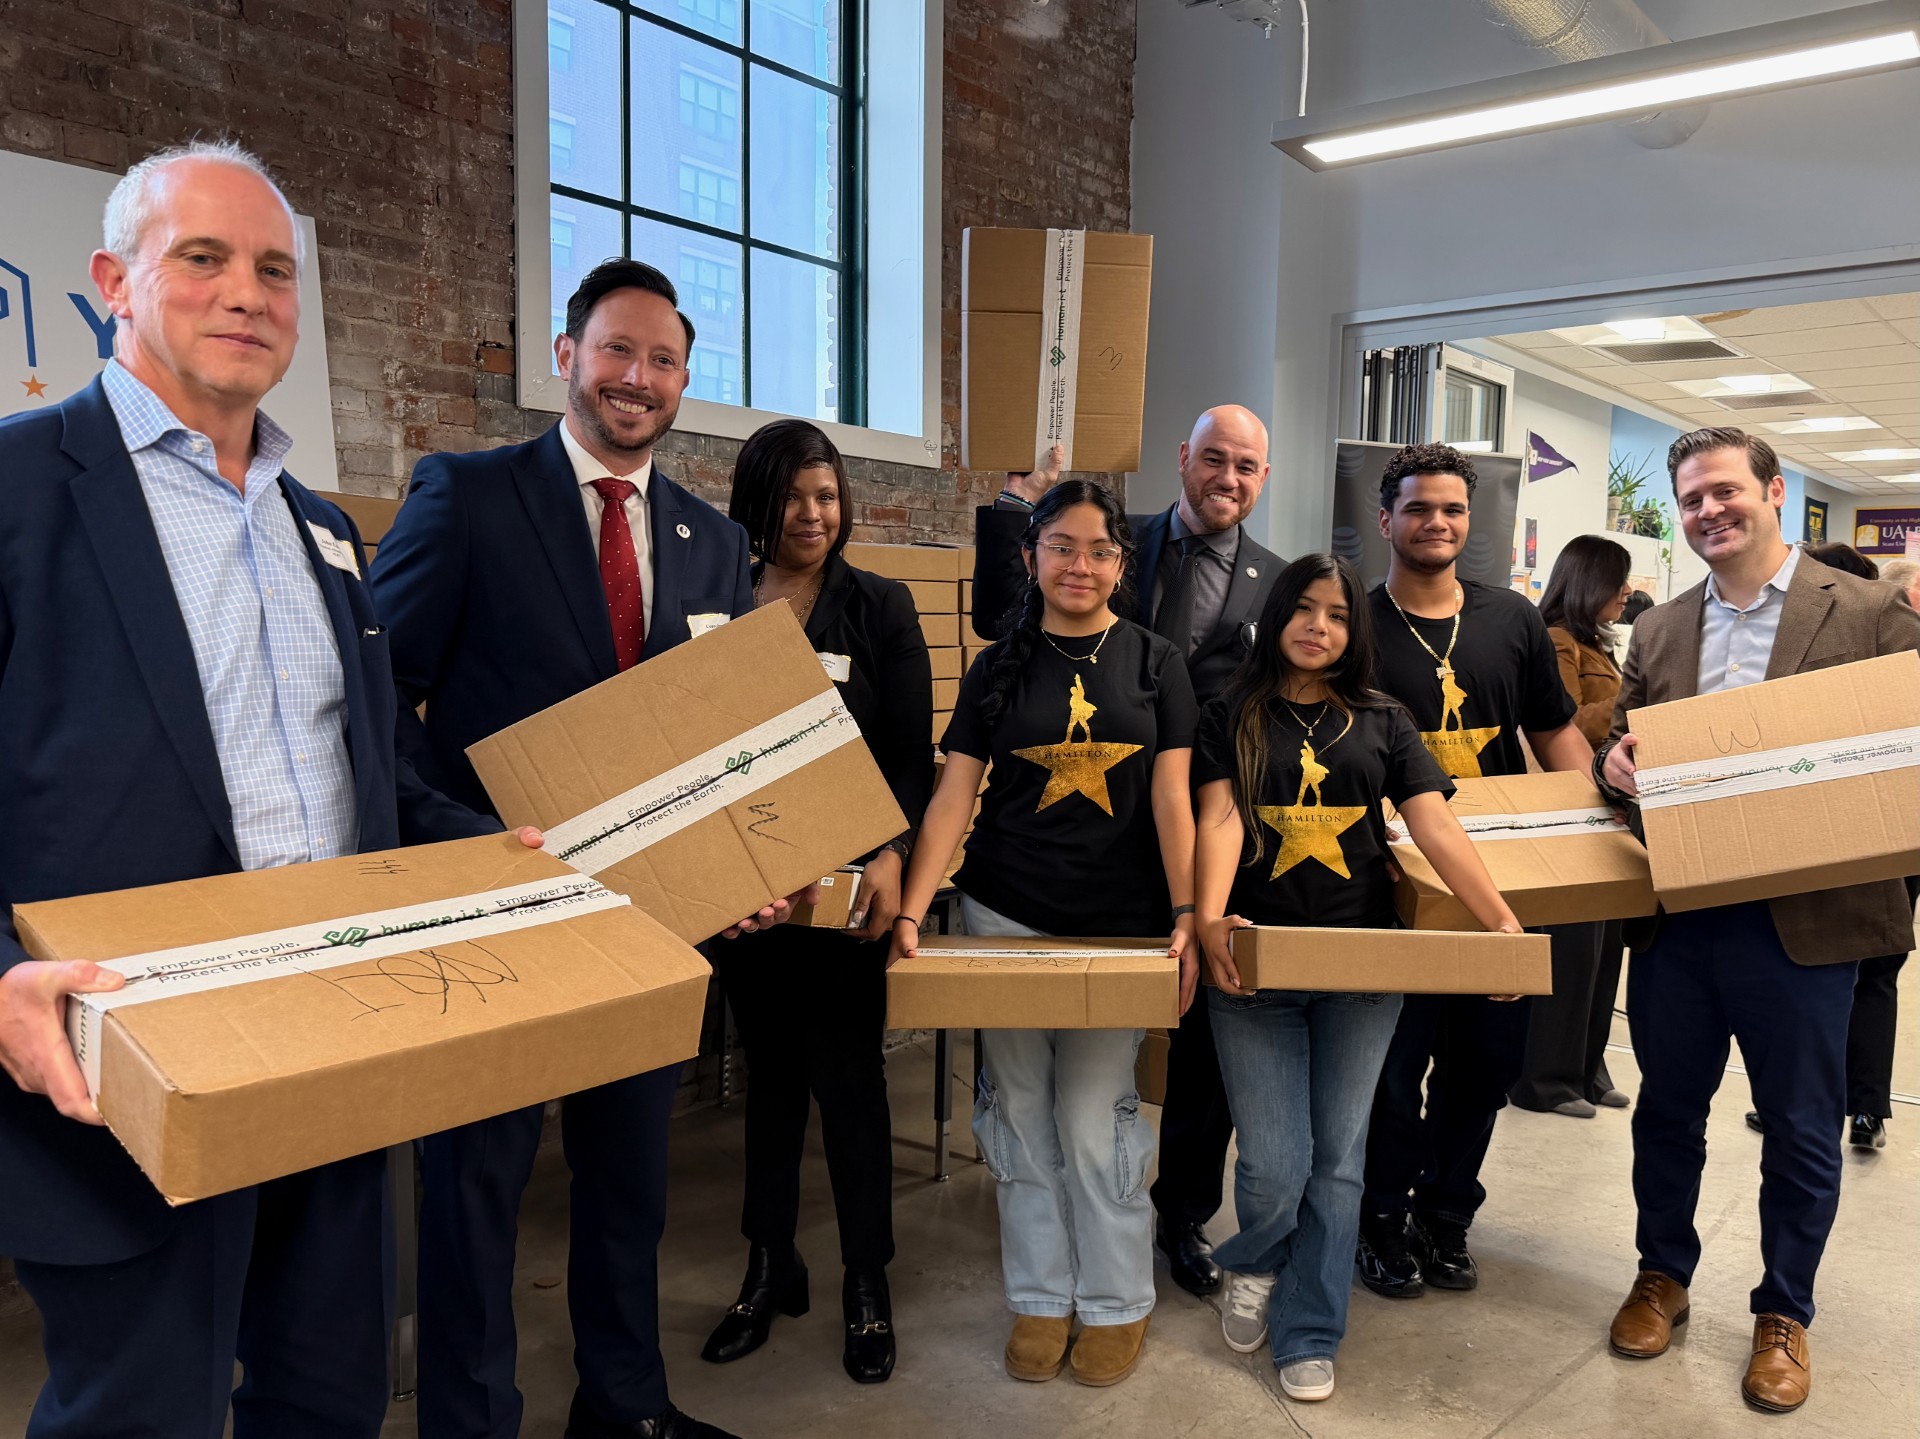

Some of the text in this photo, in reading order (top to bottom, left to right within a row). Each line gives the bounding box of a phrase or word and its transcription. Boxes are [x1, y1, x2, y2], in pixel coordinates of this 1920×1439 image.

[1044, 750, 1112, 760] HAMILTON
[1423, 736, 1480, 746] HAMILTON
[1866, 746, 1913, 759] Empower
[627, 791, 675, 818] Empower
[676, 774, 713, 794] People.
[635, 783, 725, 830] Protect the Earth.
[1277, 814, 1342, 822] HAMILTON
[146, 951, 233, 974] Empower
[238, 942, 301, 959] People.
[495, 889, 560, 907] Empower
[158, 965, 231, 984] Protect
[233, 958, 262, 971] the
[265, 951, 320, 966] Earth.
[508, 902, 561, 917] Protect
[563, 896, 585, 906] the
